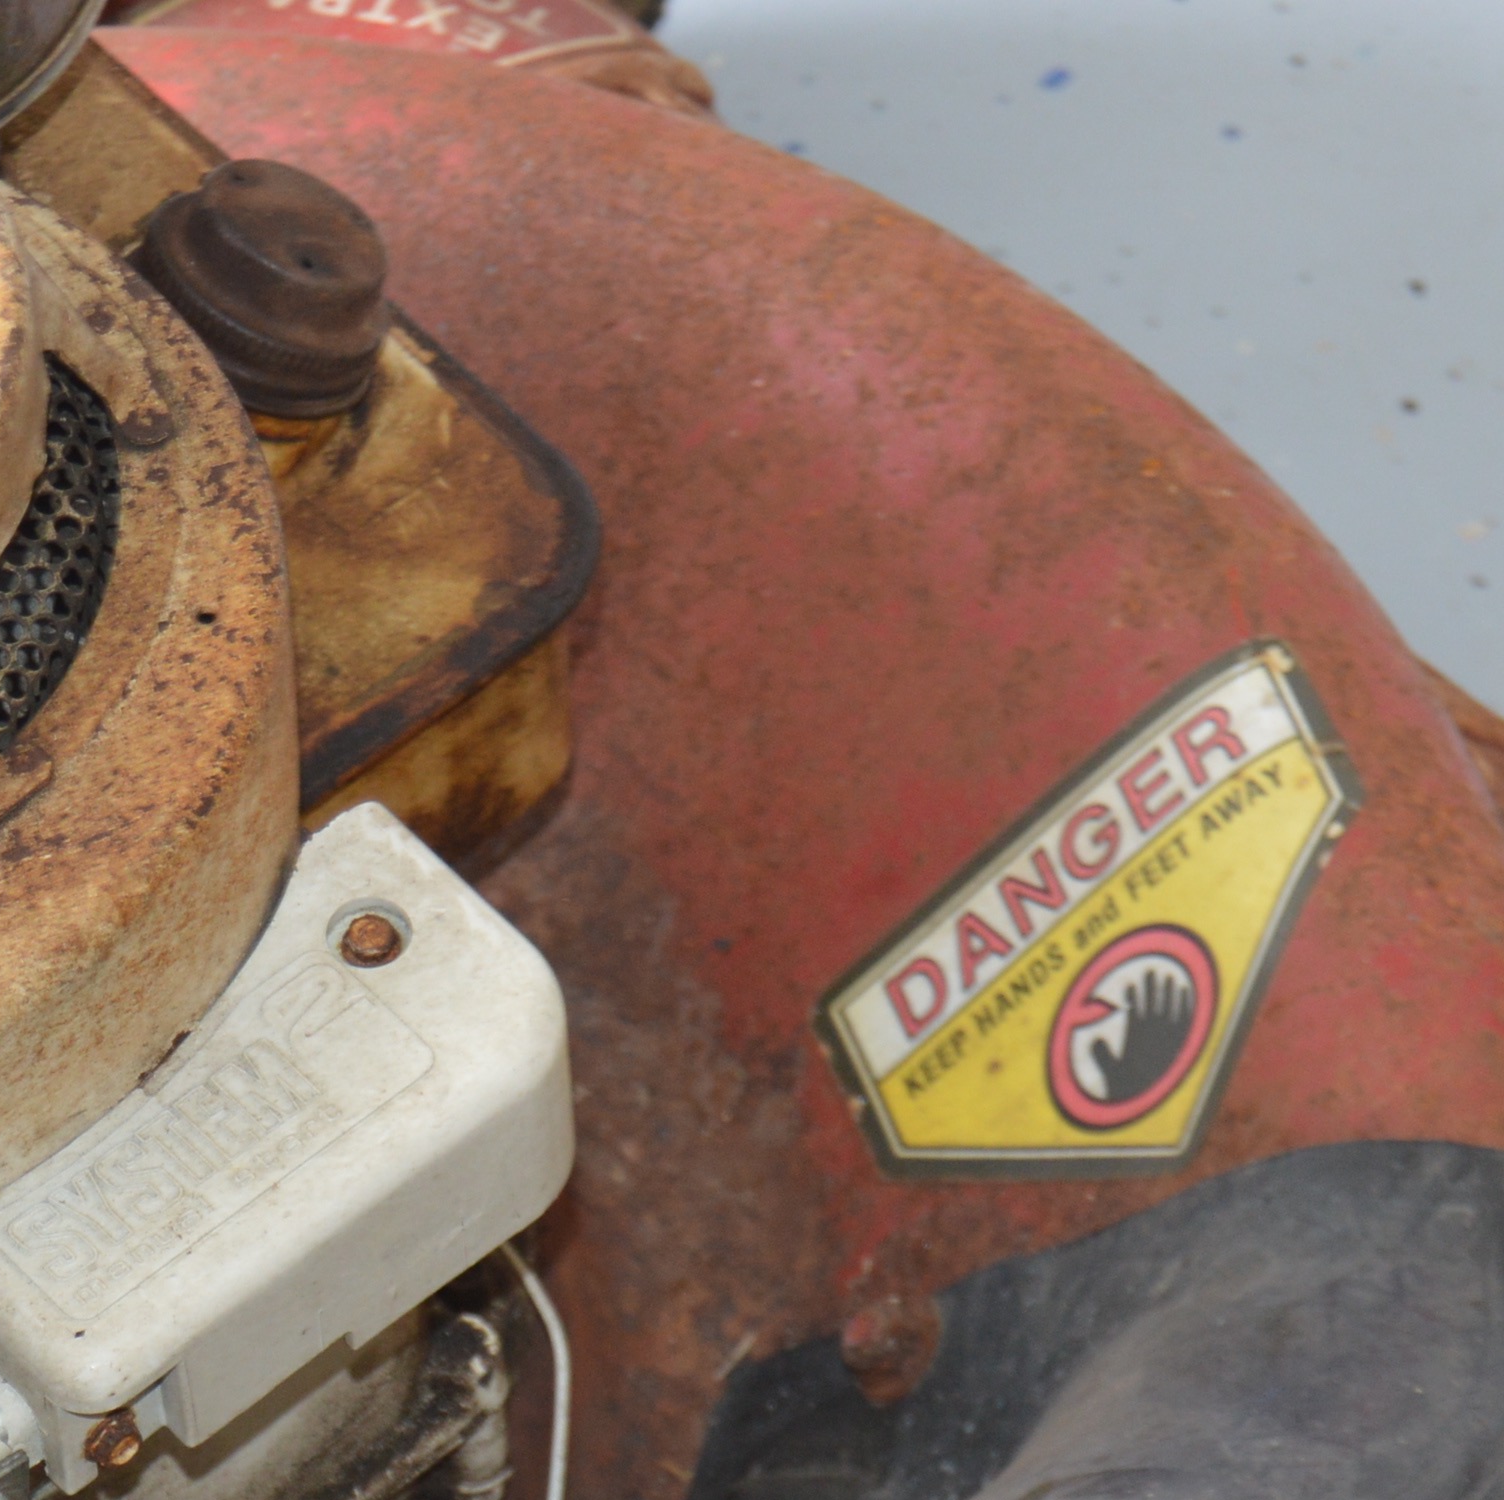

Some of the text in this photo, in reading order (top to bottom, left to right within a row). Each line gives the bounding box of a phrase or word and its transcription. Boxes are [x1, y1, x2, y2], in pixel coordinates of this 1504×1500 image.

[266, 0, 508, 51] EXTR
[884, 704, 1248, 1041] DANGER
[902, 761, 1288, 1100] KEEP HANDS and FEET AWAY
[7, 961, 376, 1282] SYSTEM 2
